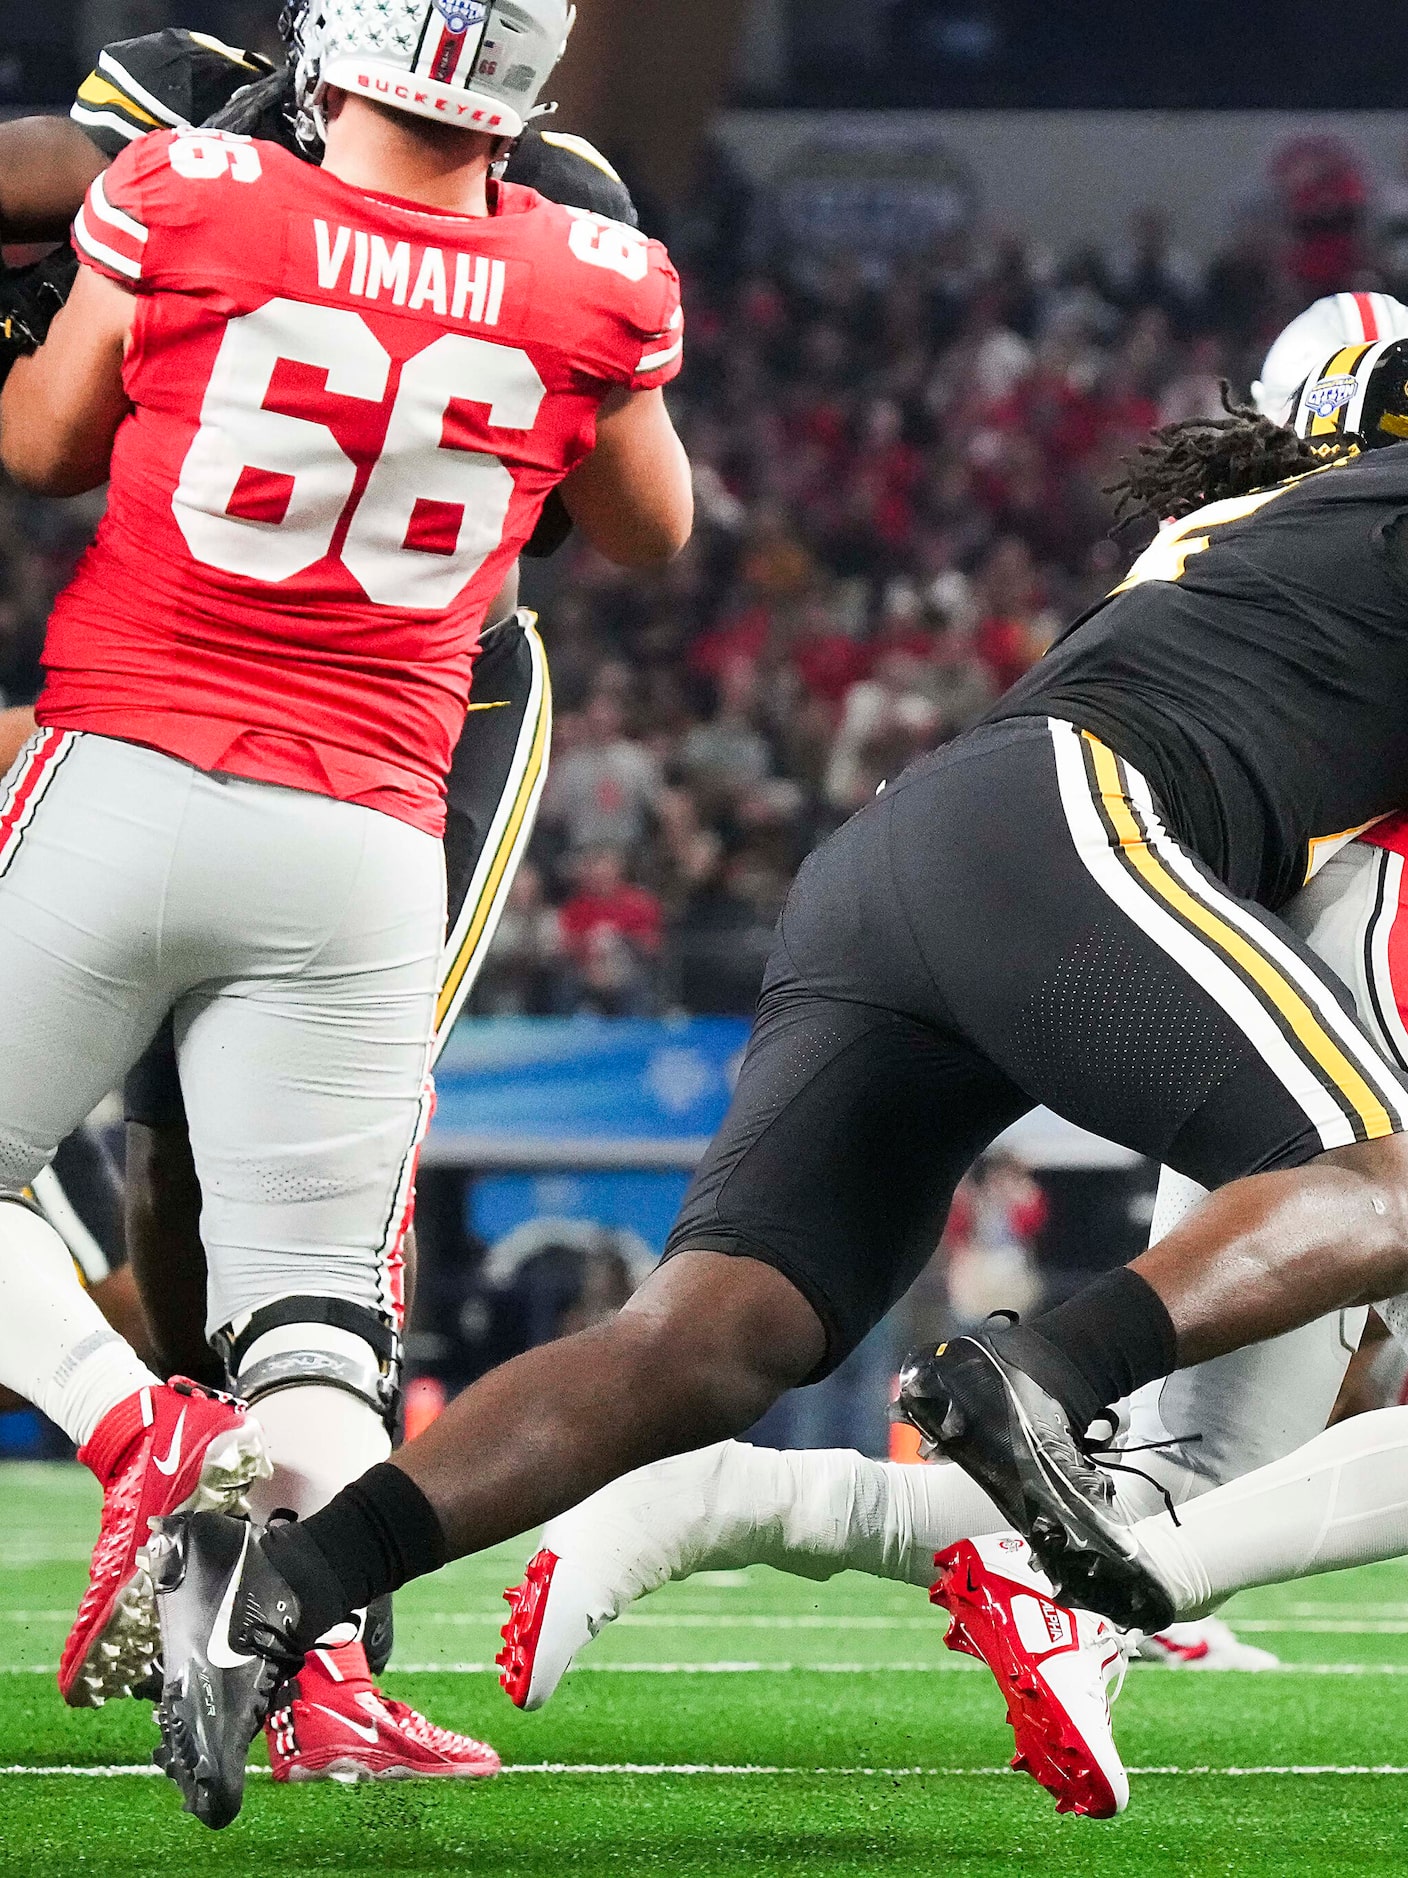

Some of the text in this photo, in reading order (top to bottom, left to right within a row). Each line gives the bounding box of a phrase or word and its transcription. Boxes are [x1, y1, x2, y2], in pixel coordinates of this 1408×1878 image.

[357, 74, 502, 126] BUCKEYES
[313, 219, 505, 325] VIMAHI
[171, 297, 547, 608] 66
[1039, 1599, 1063, 1642] ALPHA
